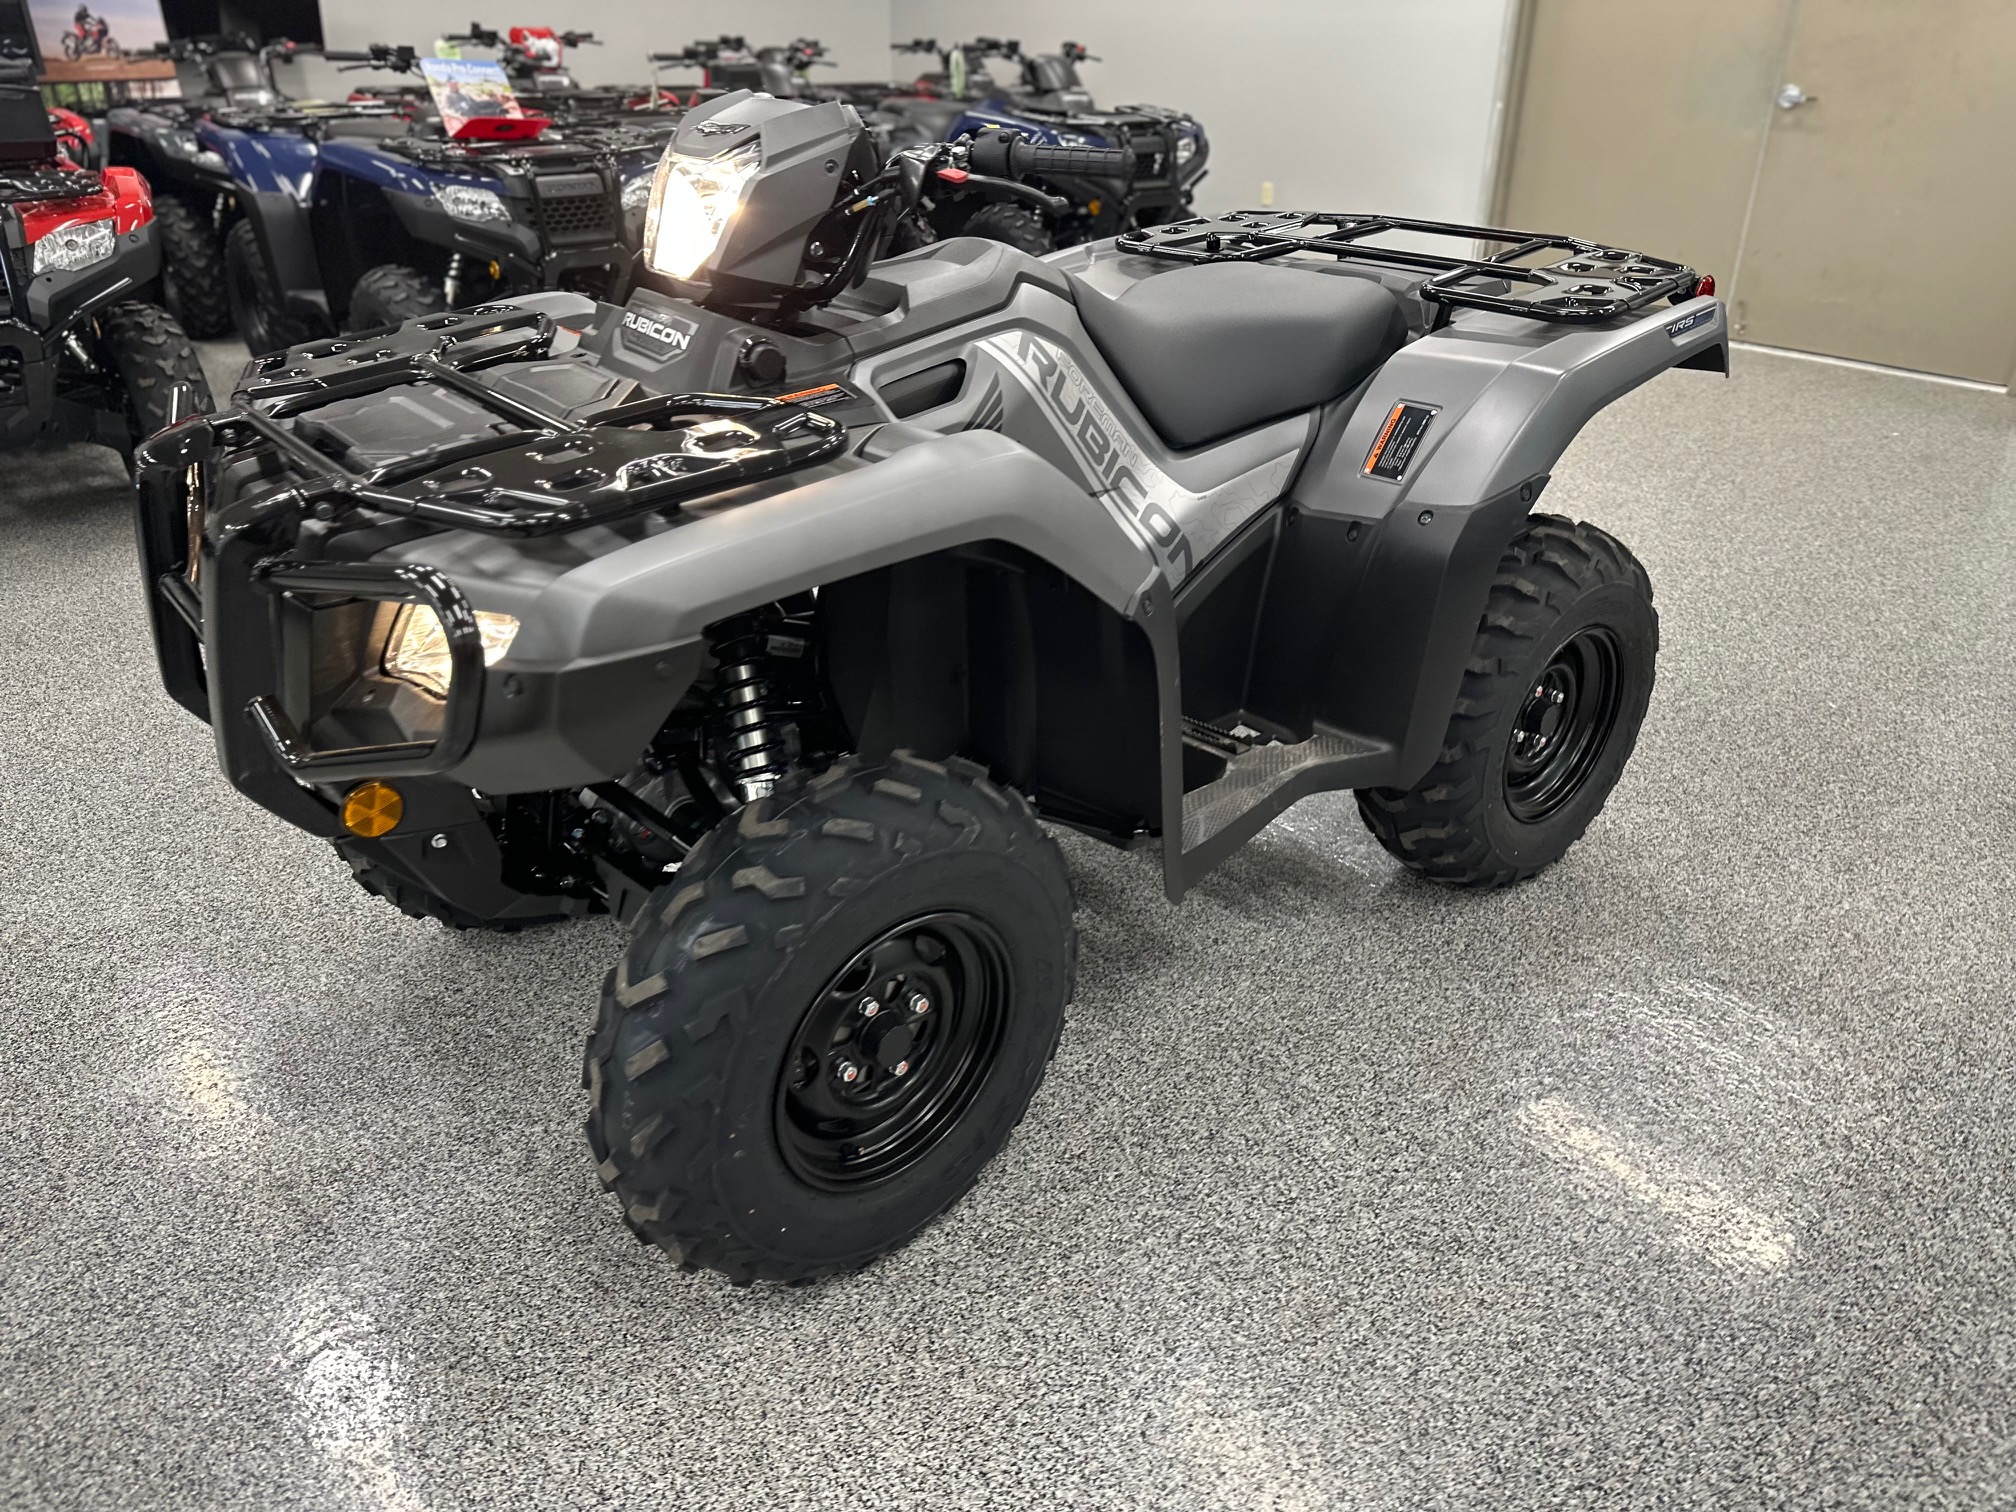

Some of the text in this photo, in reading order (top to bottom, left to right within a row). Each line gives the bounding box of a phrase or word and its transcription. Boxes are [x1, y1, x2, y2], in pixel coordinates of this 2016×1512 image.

[622, 311, 691, 350] RUBICON
[1671, 315, 1695, 333] IRS
[1055, 347, 1138, 467] FOREMAN
[1376, 418, 1397, 451] WARNING
[1016, 331, 1194, 579] RUBICON
